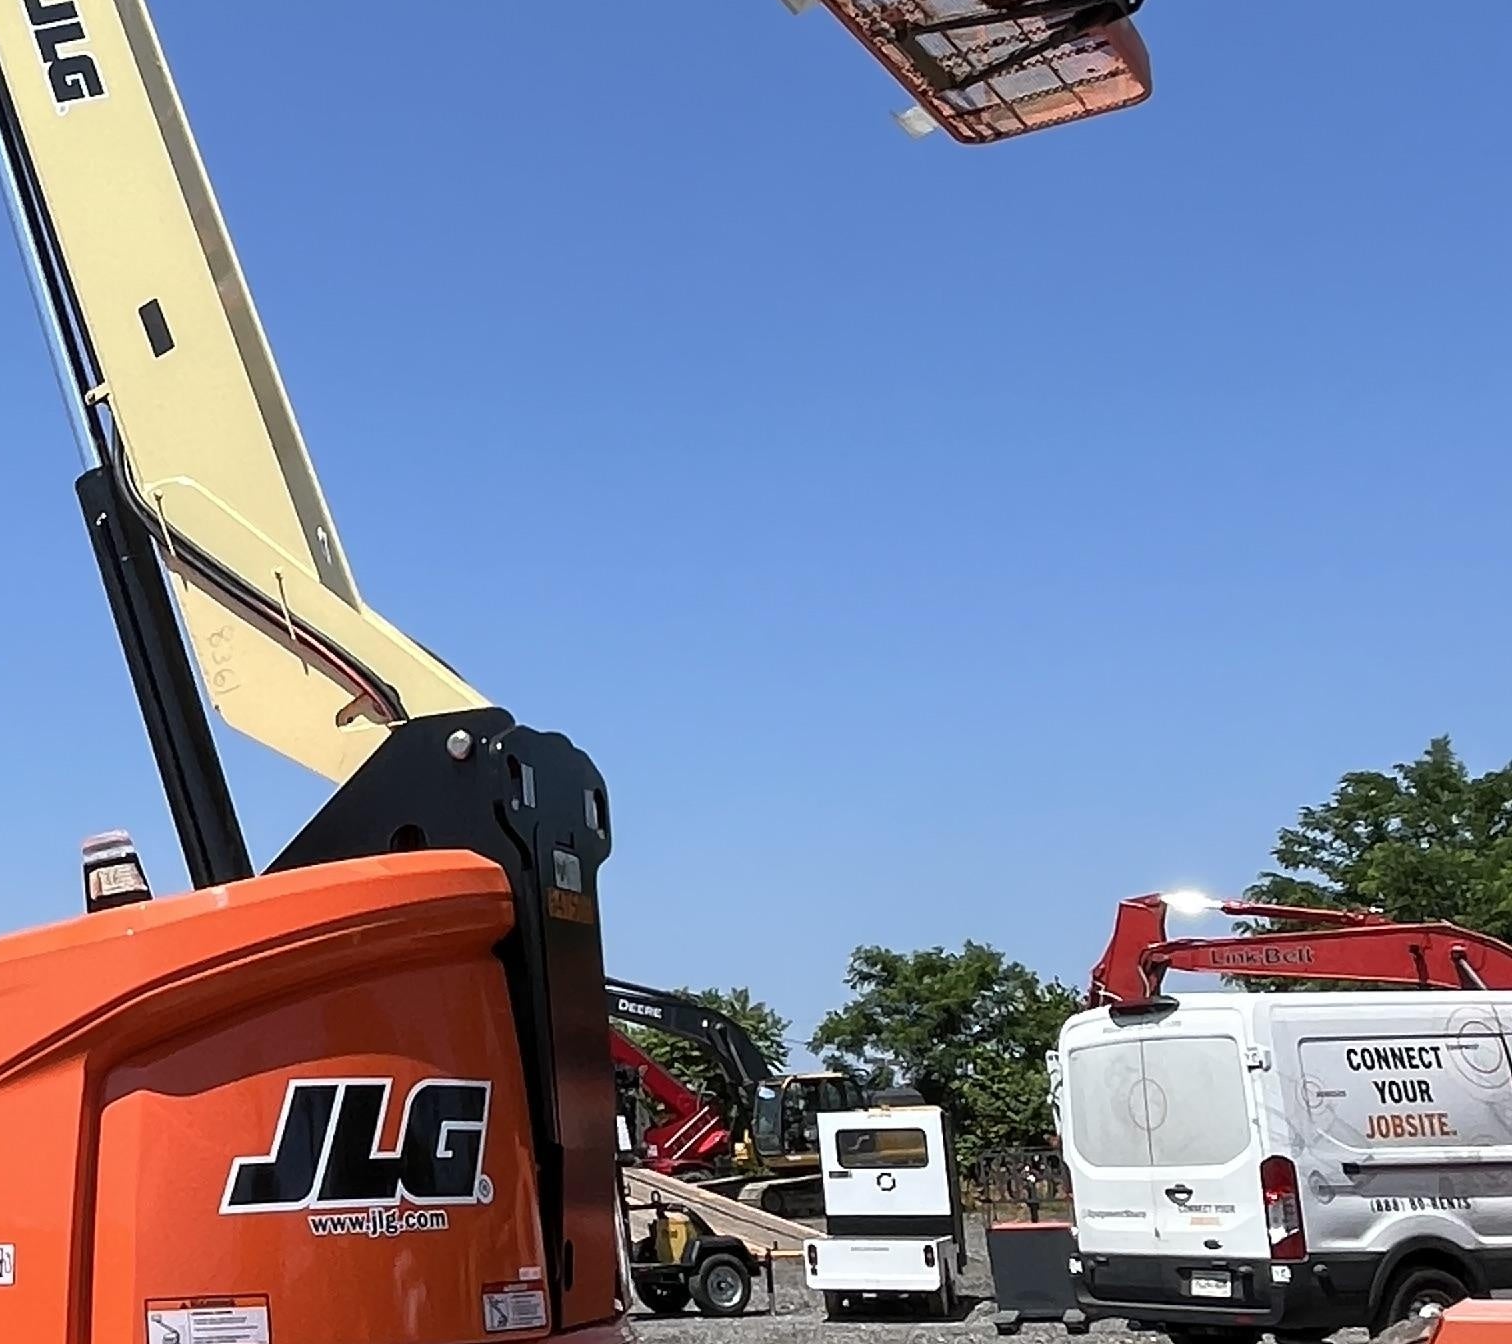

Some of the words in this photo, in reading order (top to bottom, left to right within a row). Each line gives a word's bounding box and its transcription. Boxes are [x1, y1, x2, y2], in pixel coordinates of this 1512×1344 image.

[618, 998, 662, 1019] DEERE
[1346, 1046, 1443, 1071] CONNECT
[1372, 1080, 1433, 1104] YOUR
[1366, 1113, 1458, 1139] JOBSITE.
[219, 1078, 491, 1214] JLG
[309, 1209, 448, 1236] www.jlg.com
